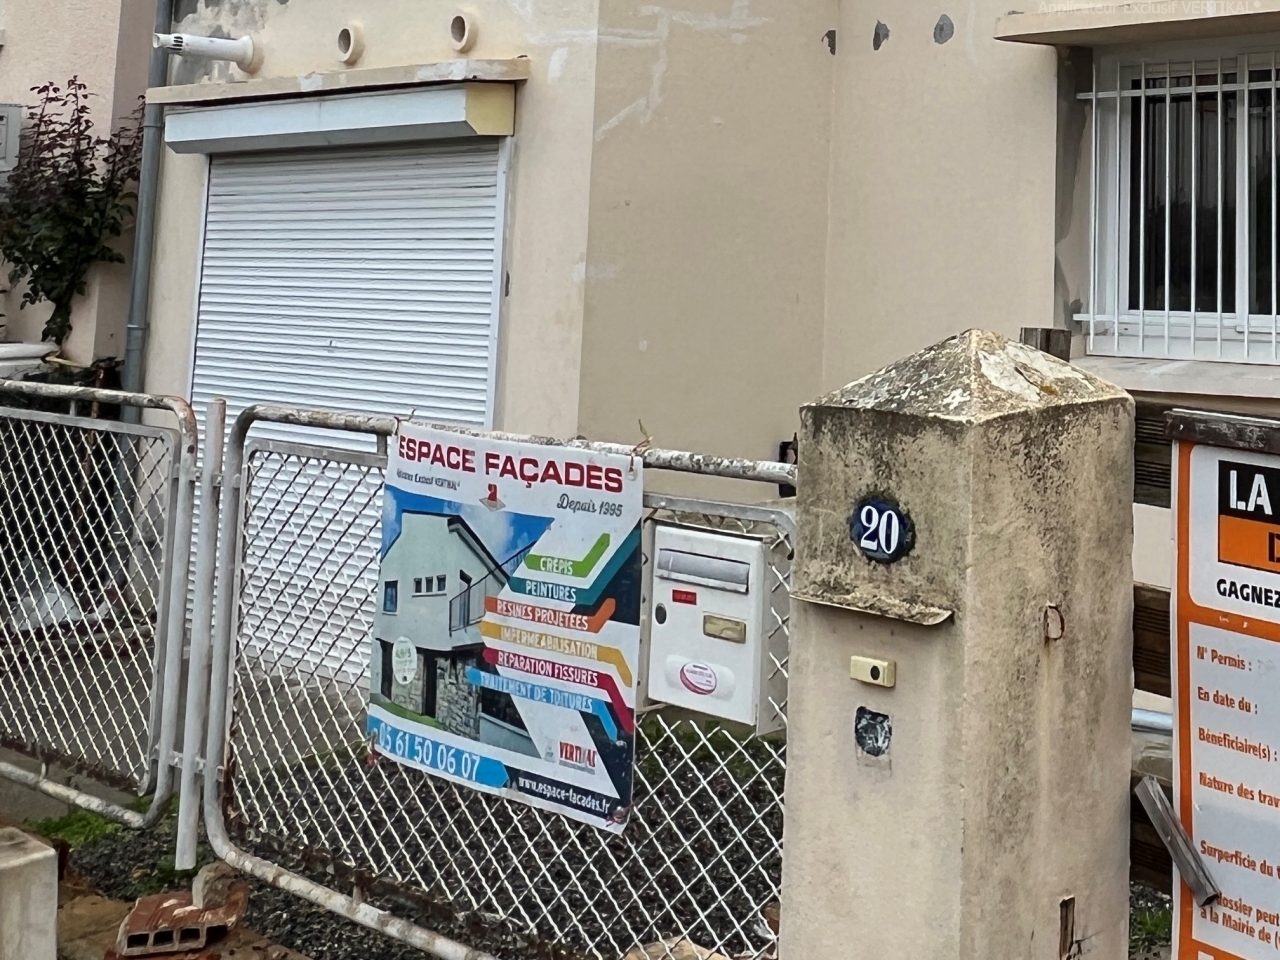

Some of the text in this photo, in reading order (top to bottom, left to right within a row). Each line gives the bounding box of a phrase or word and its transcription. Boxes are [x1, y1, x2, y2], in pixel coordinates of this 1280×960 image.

[398, 434, 476, 473] ESPACE
[485, 452, 624, 494] FAÇADES
[1229, 469, 1272, 516] LA
[860, 505, 900, 554] 20
[525, 580, 577, 602] PEINTURES
[1211, 648, 1246, 671] Permis
[554, 666, 599, 687] FISSURES
[534, 685, 547, 702] DE
[550, 689, 593, 714] TOITURES
[1198, 686, 1210, 702] En
[1213, 690, 1236, 709] date
[1238, 697, 1252, 714] du
[395, 732, 409, 758] 61
[414, 737, 433, 766] 50
[437, 744, 456, 774] 06
[461, 753, 481, 782] 07
[1199, 771, 1234, 795] Nature
[1237, 782, 1255, 801] des
[1259, 859, 1274, 878] du
[1209, 906, 1219, 924] la
[1222, 912, 1256, 941] Mairie
[1258, 926, 1272, 945] de
[1256, 907, 1280, 929] peut
